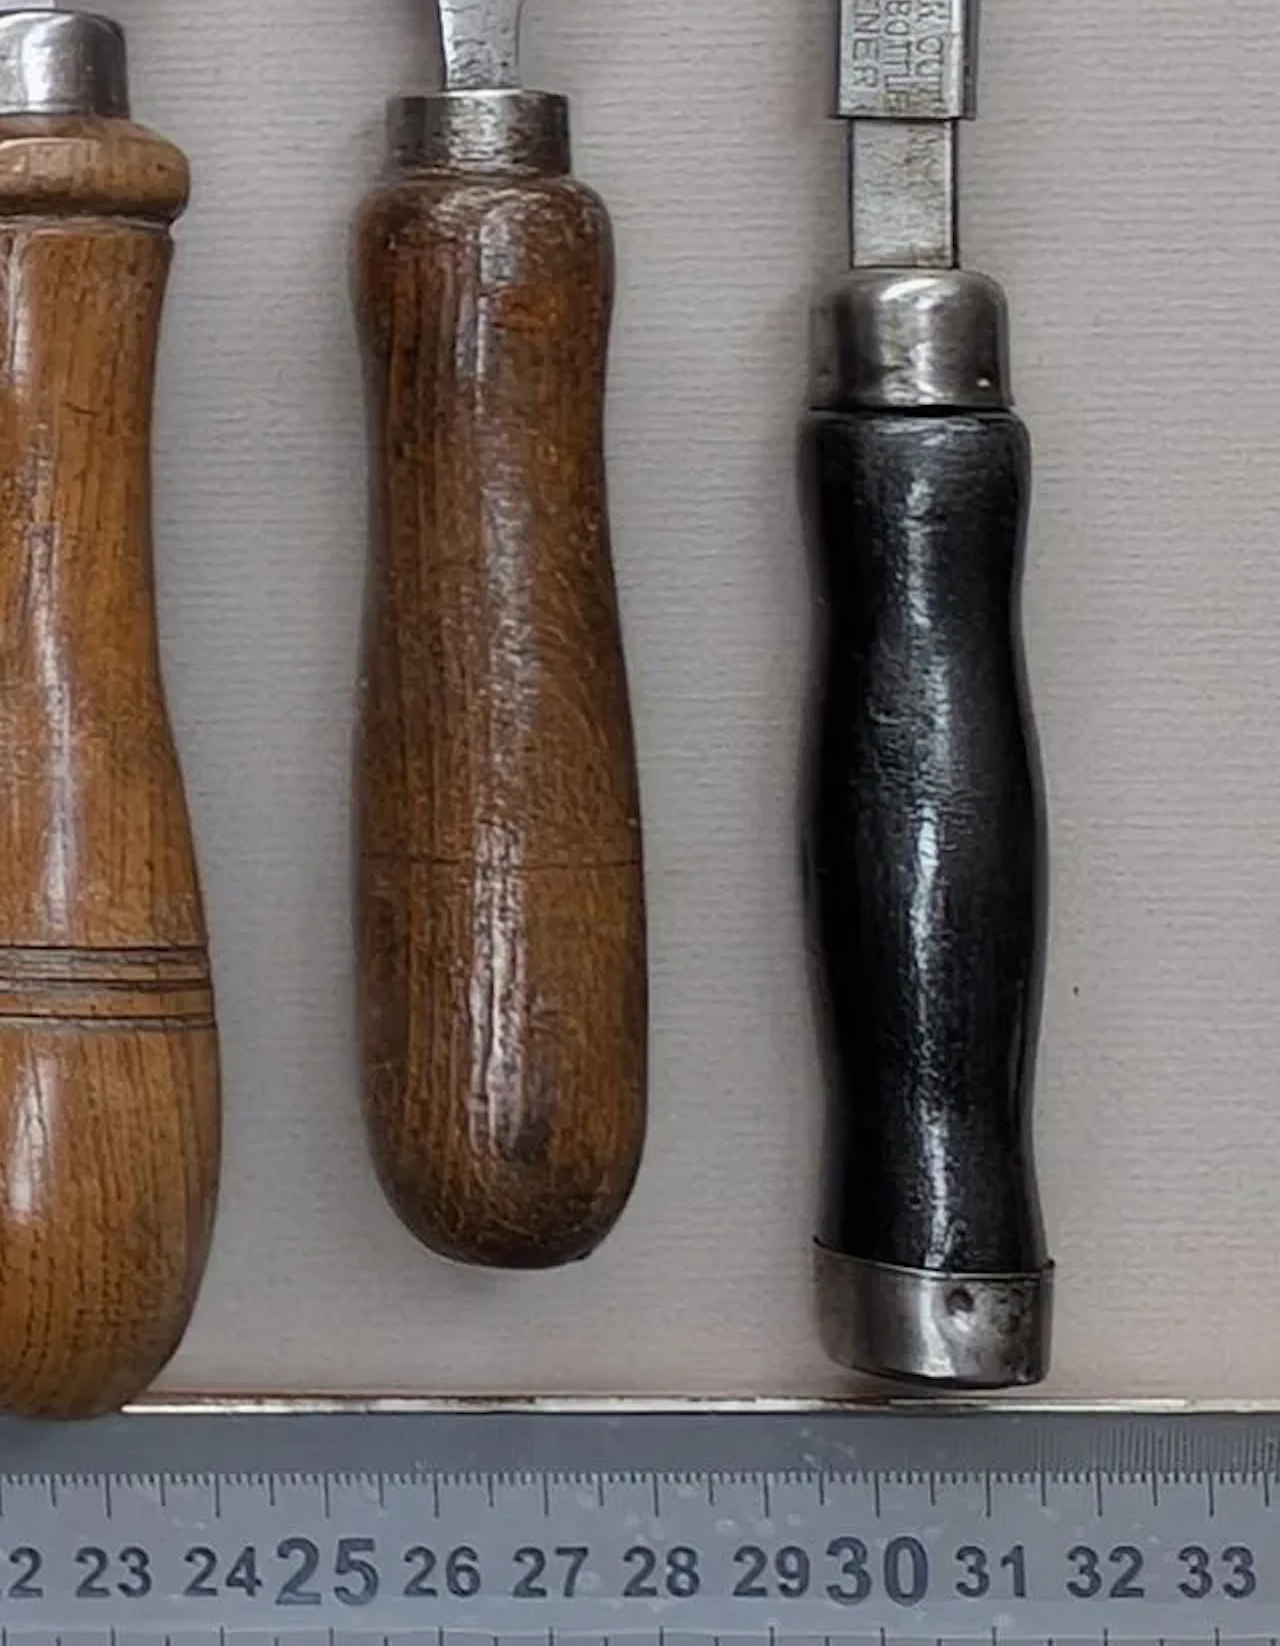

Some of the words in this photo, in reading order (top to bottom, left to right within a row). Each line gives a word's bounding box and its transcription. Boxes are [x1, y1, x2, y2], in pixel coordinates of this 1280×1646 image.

[74, 1546, 152, 1598] 23
[183, 1546, 263, 1598] 24
[275, 1537, 379, 1606] 25
[403, 1546, 481, 1598] 26
[511, 1546, 589, 1598] 27
[622, 1546, 700, 1598] 28
[732, 1545, 810, 1598] 29
[826, 1536, 928, 1606] 30
[955, 1545, 1026, 1598] 31
[1066, 1546, 1145, 1598] 32
[1177, 1546, 1256, 1599] 33
